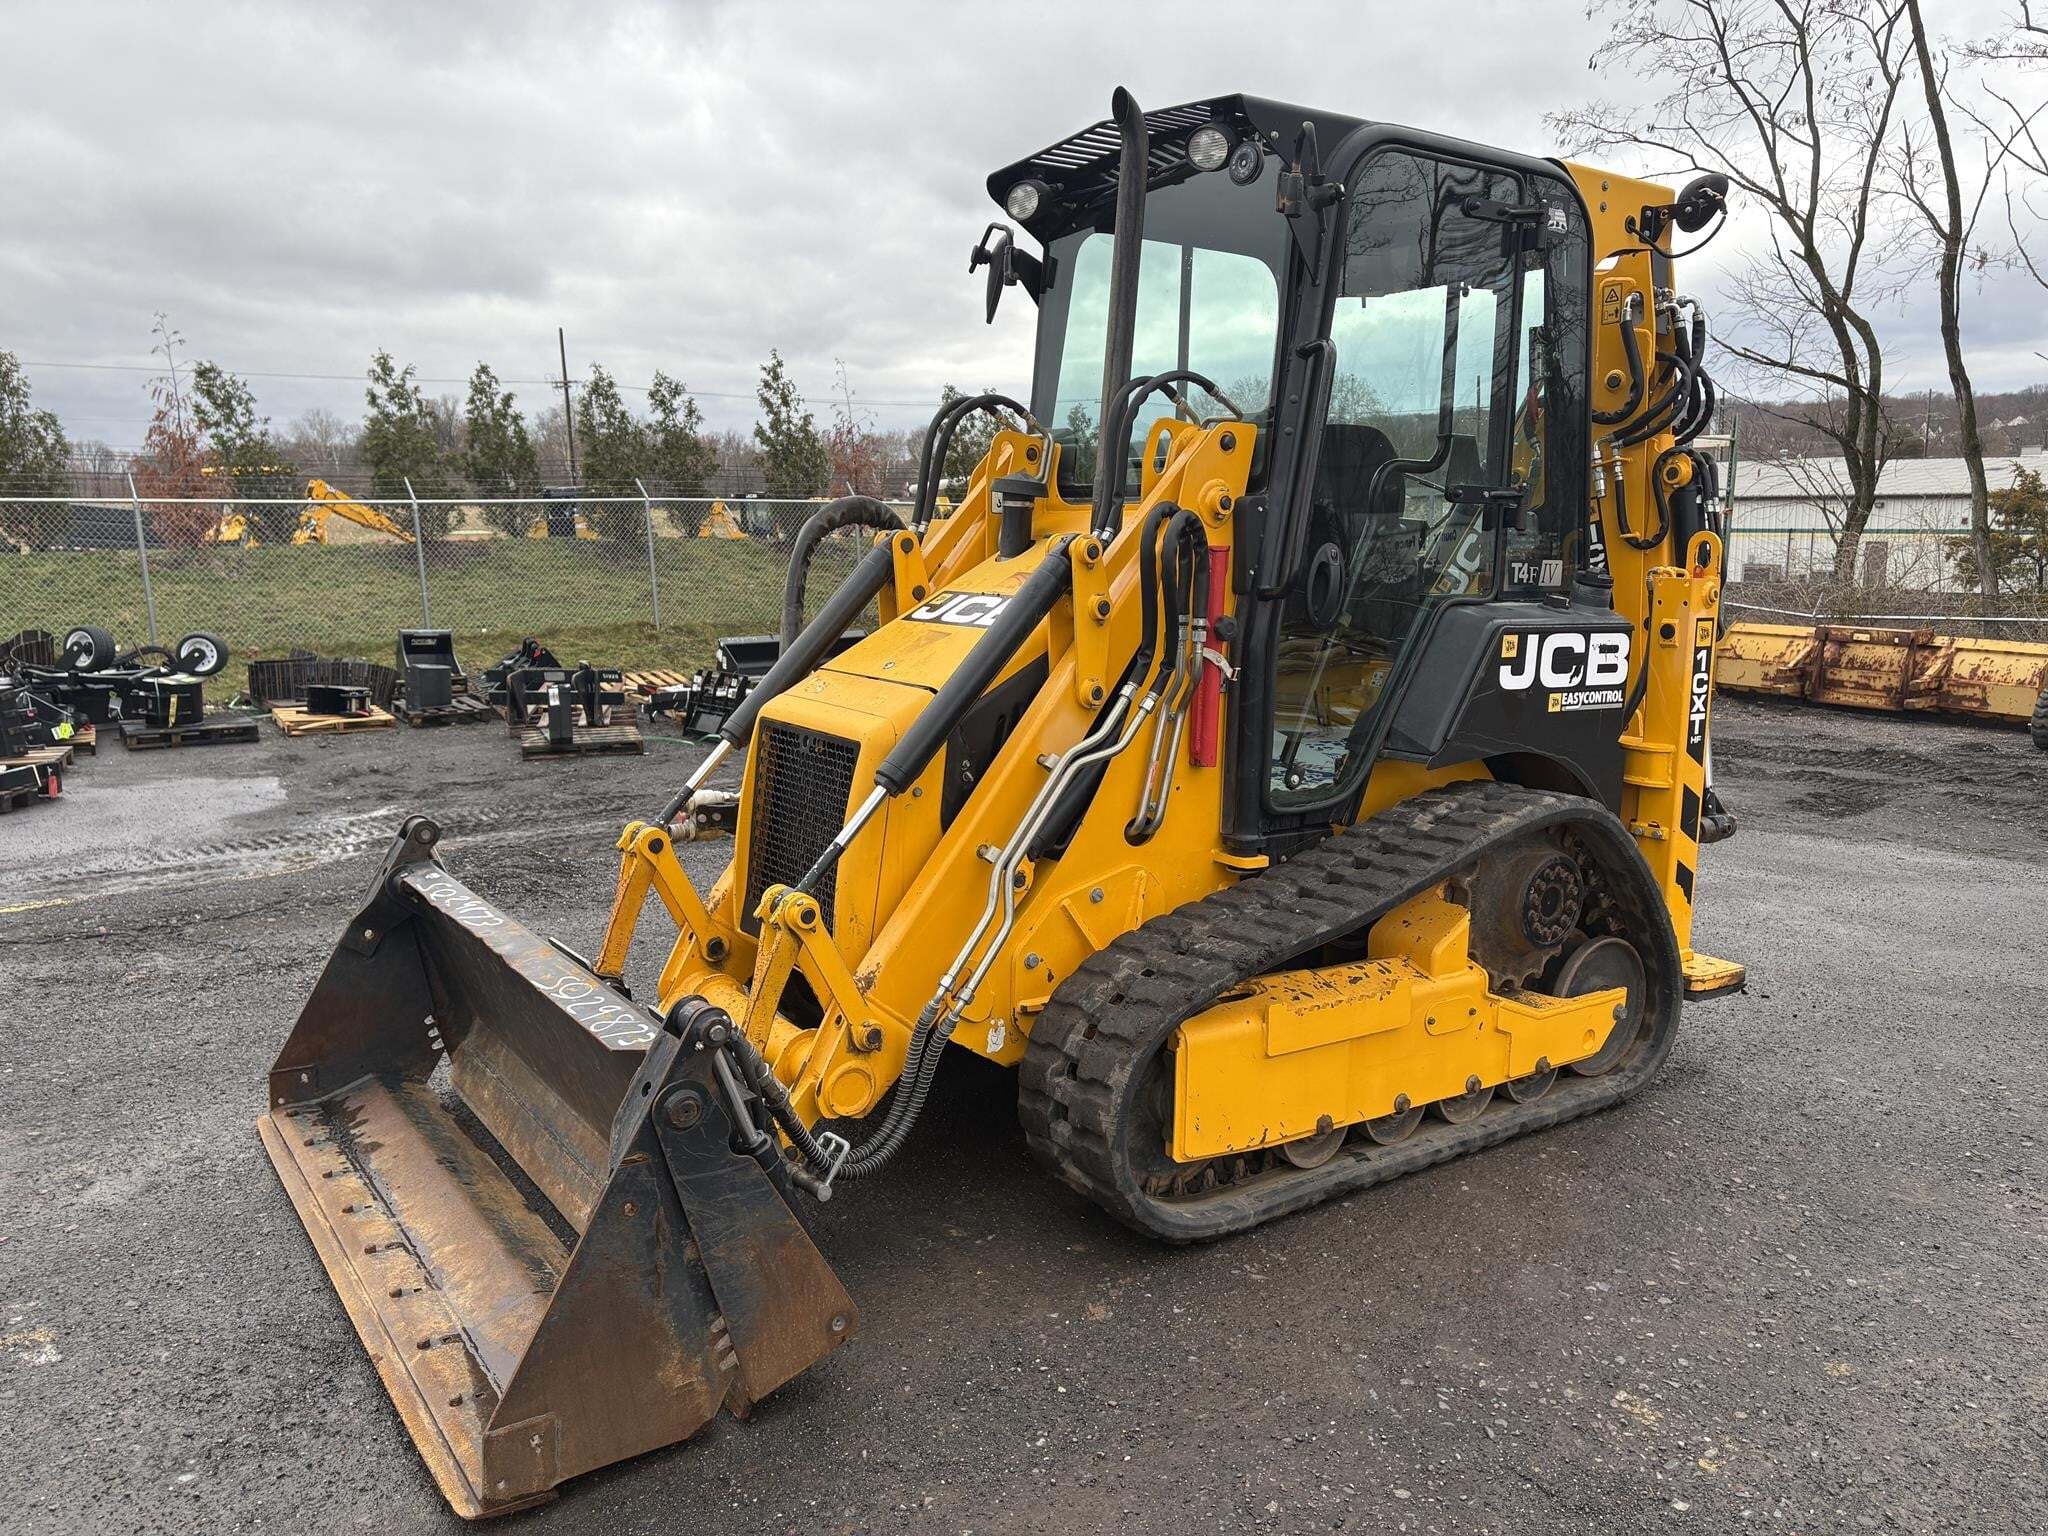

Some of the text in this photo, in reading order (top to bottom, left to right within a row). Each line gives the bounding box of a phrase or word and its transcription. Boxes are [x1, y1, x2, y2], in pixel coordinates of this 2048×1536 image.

[1498, 632, 1630, 690] JCB
[1561, 690, 1624, 708] EASYCONTROL
[1690, 649, 1709, 744] 1CXT HF
